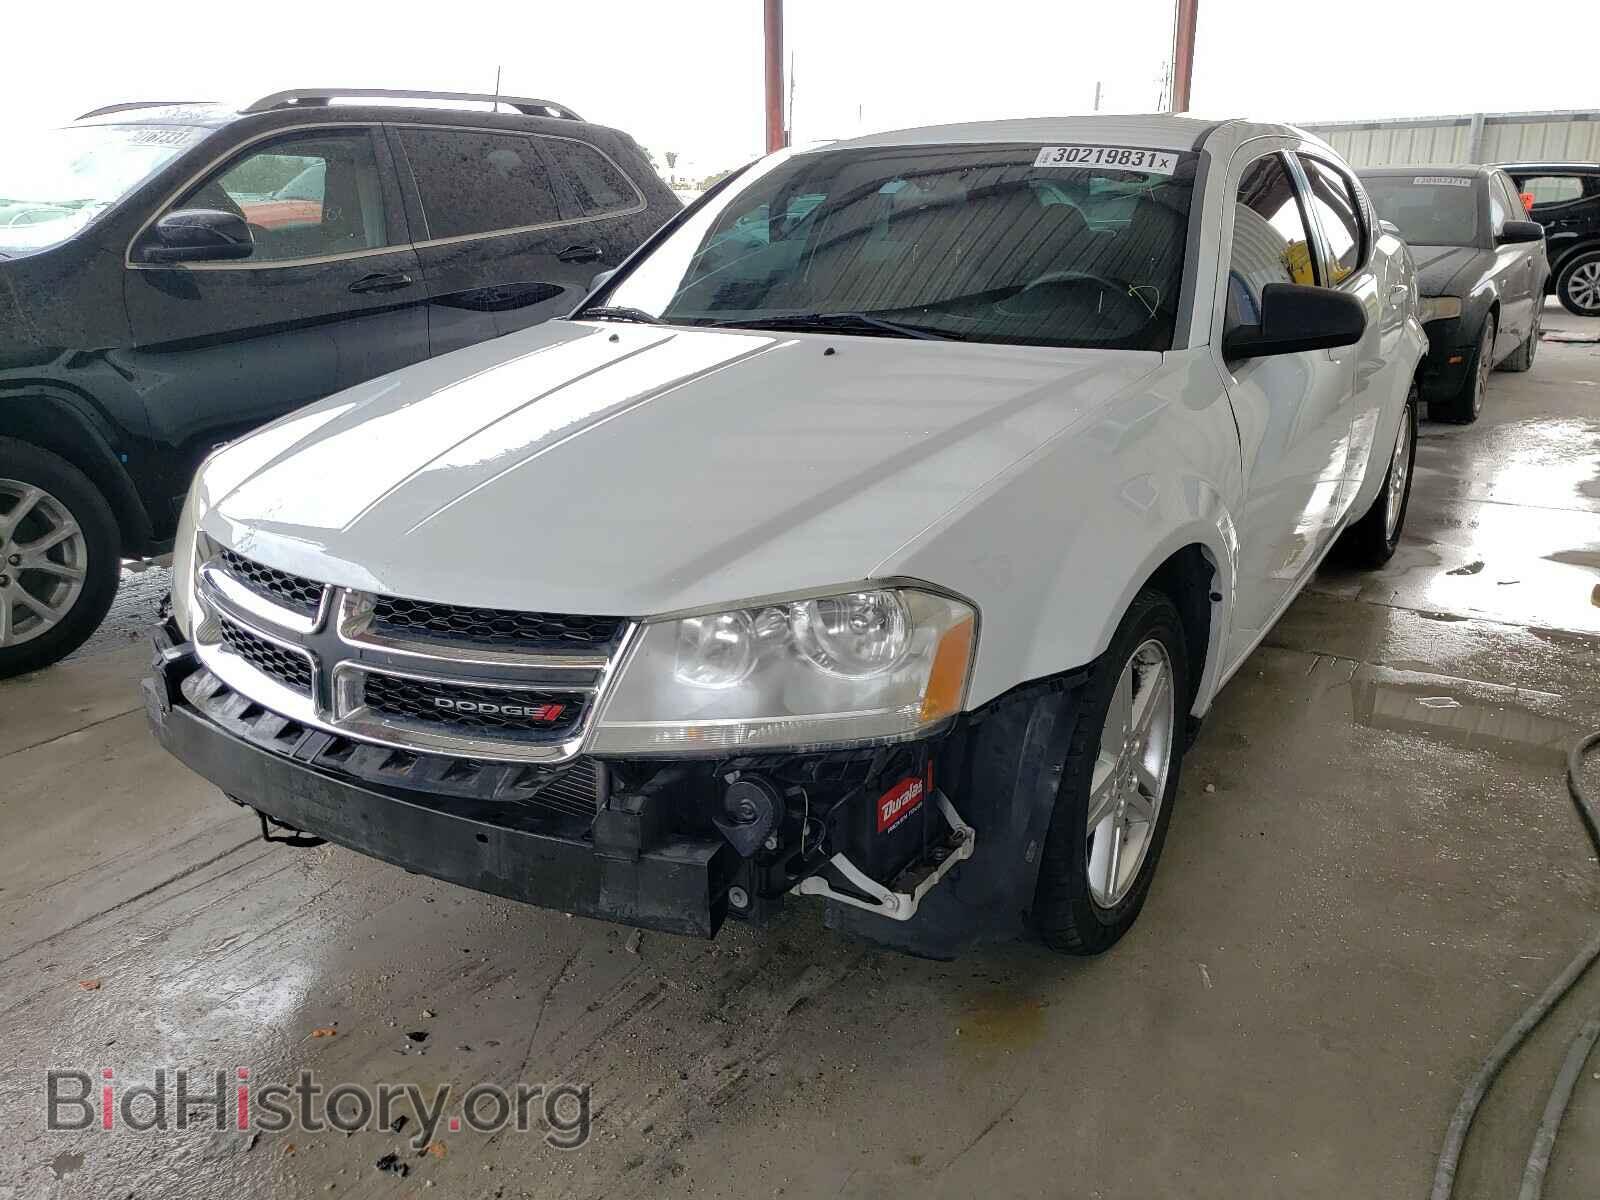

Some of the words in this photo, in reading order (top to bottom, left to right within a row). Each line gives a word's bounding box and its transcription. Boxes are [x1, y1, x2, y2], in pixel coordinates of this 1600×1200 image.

[1053, 148, 1156, 168] 30219831
[434, 697, 545, 717] DODGE
[881, 779, 923, 822] Duralas
